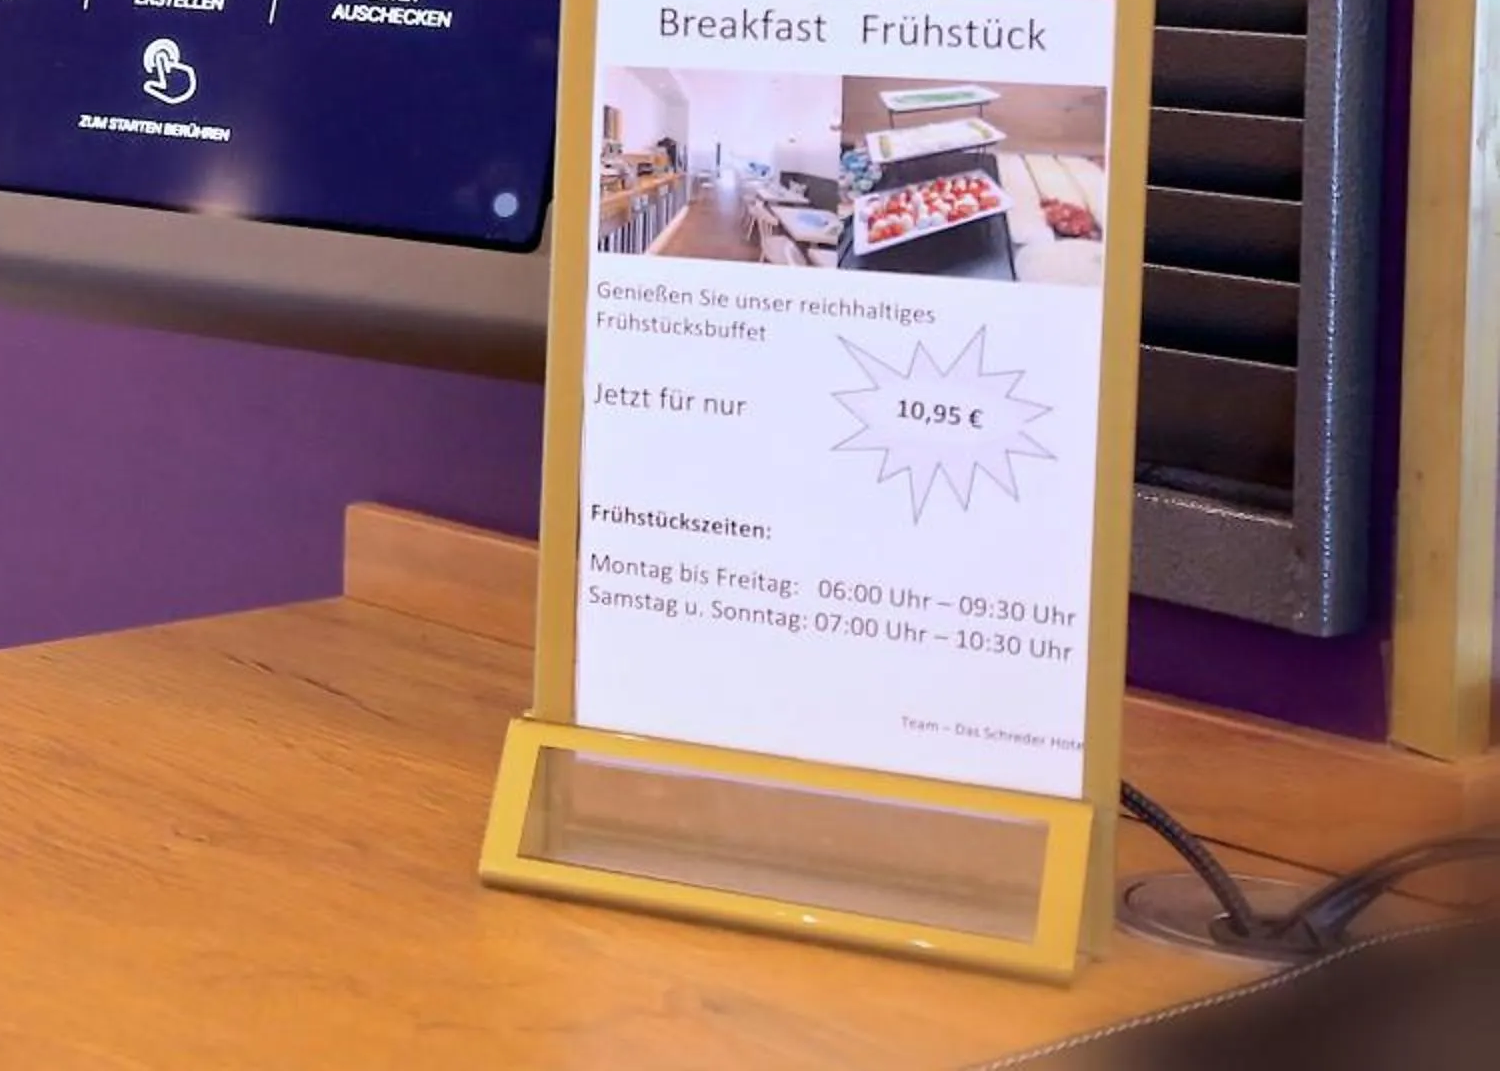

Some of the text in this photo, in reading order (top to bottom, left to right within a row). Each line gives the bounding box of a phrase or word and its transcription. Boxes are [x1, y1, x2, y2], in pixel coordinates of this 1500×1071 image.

[331, 3, 453, 28] AUSCHECKEN
[658, 7, 1047, 52] Breakfast Frühstück
[78, 114, 231, 142] ZUM STARTEN BERÜHREN
[596, 280, 937, 327] Genießen Sie unser reichhaltiges
[596, 310, 767, 342] Frühstücksbuffet
[593, 383, 747, 417] Jetzt für nur
[897, 399, 984, 429] 10,95 €
[590, 504, 772, 540] Frühstückszeiten:
[590, 553, 673, 585] Montag
[680, 562, 709, 585] bis
[717, 567, 799, 598] Freitag:
[818, 579, 883, 605] 06:00
[889, 588, 932, 610] Uhr
[959, 595, 1026, 622] 09:30
[1033, 604, 1077, 627] Uhr
[589, 585, 678, 618] Samstag
[685, 603, 704, 618] u.
[711, 600, 808, 633] Sonntag:
[814, 612, 879, 638] 07:00
[886, 621, 928, 643] Uhr
[956, 629, 1021, 656] 10:30
[1029, 638, 1073, 661] Uhr
[901, 715, 939, 732] Team
[955, 722, 981, 738] Das
